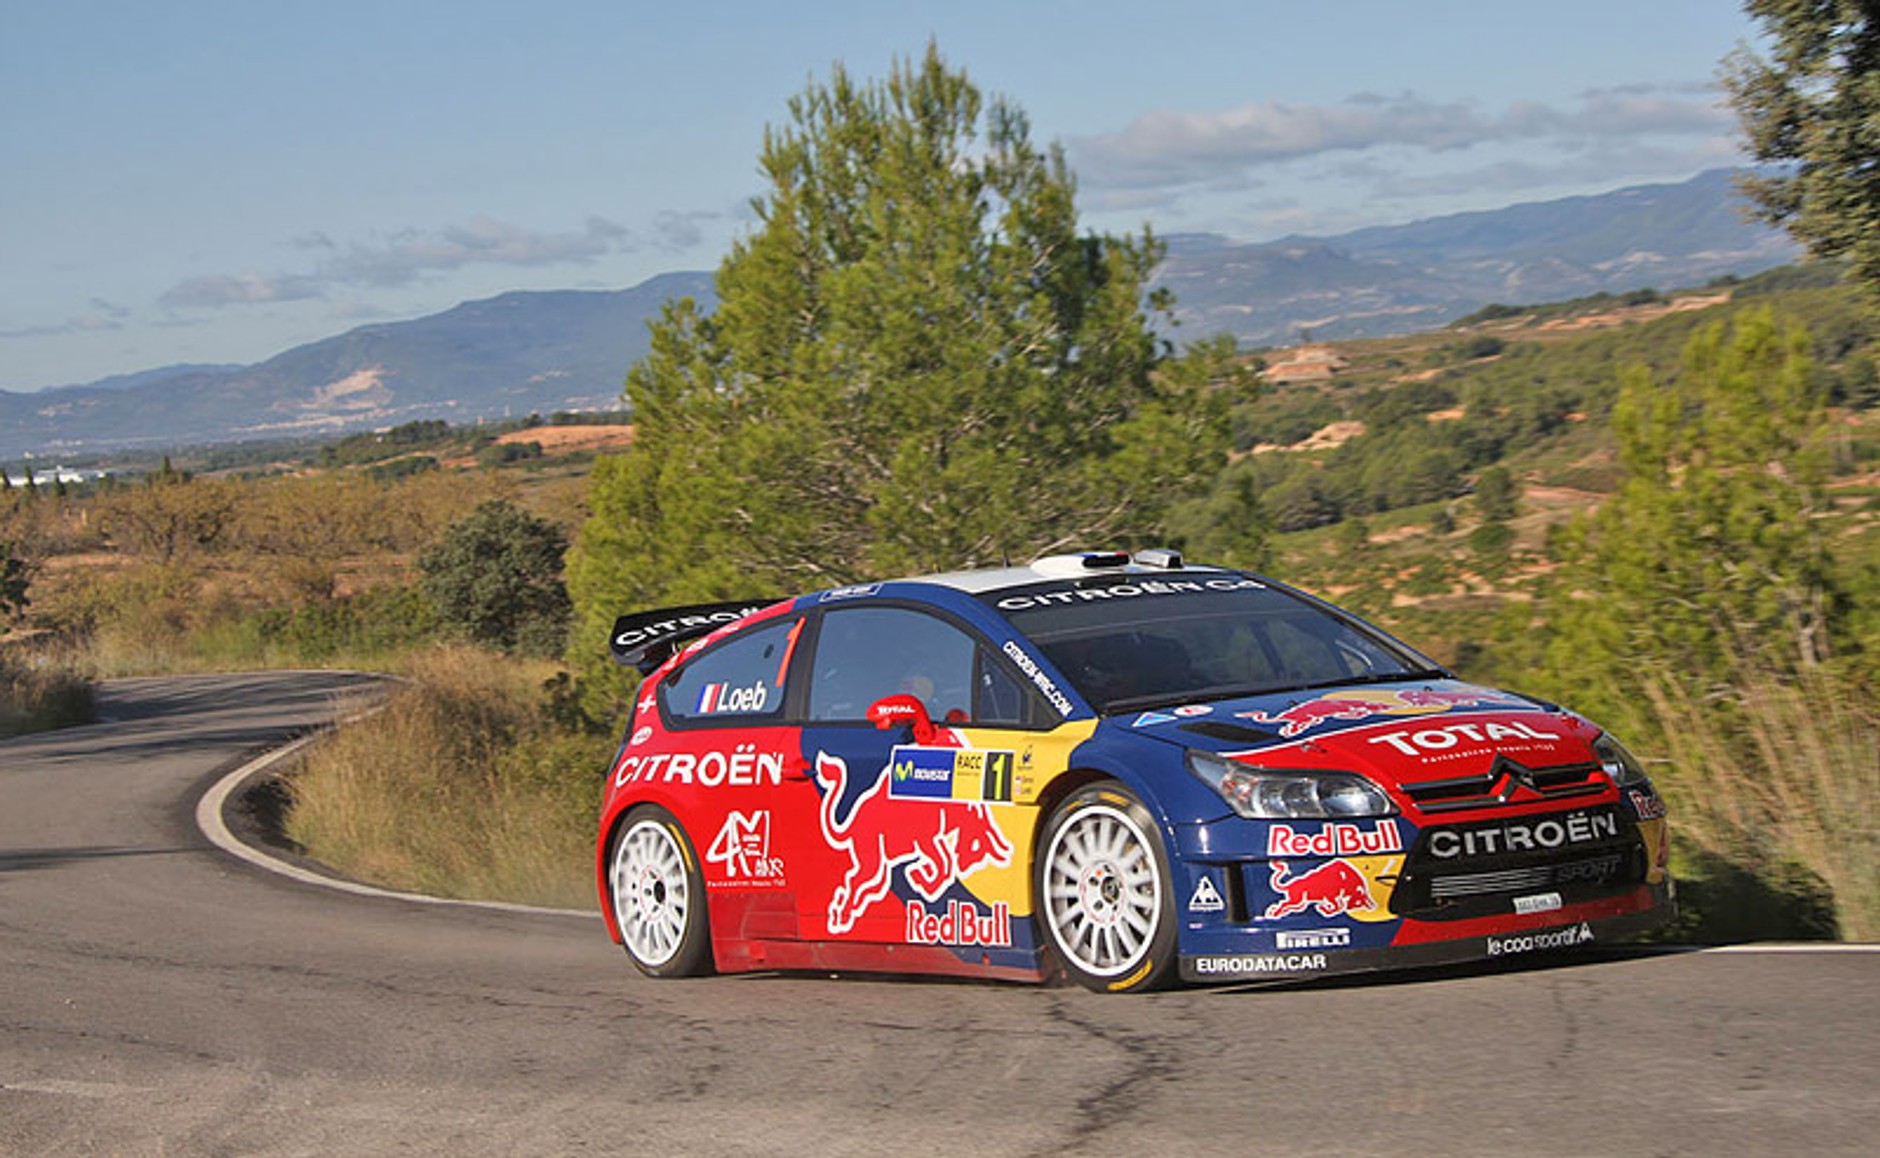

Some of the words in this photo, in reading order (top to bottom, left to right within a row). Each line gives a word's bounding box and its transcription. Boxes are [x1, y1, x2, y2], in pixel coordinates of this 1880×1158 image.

[717, 681, 766, 711] Loeb
[877, 705, 916, 716] TOTAL
[1368, 721, 1560, 756] TOTAL
[615, 744, 784, 788] CITROËN
[992, 753, 1006, 800] 1
[1267, 822, 1335, 857] Red
[1336, 819, 1402, 855] Bull
[1430, 812, 1618, 858] CITROËN
[907, 899, 957, 943] Red
[958, 901, 1012, 947] Bull
[1195, 954, 1326, 972] EURODATACAR
